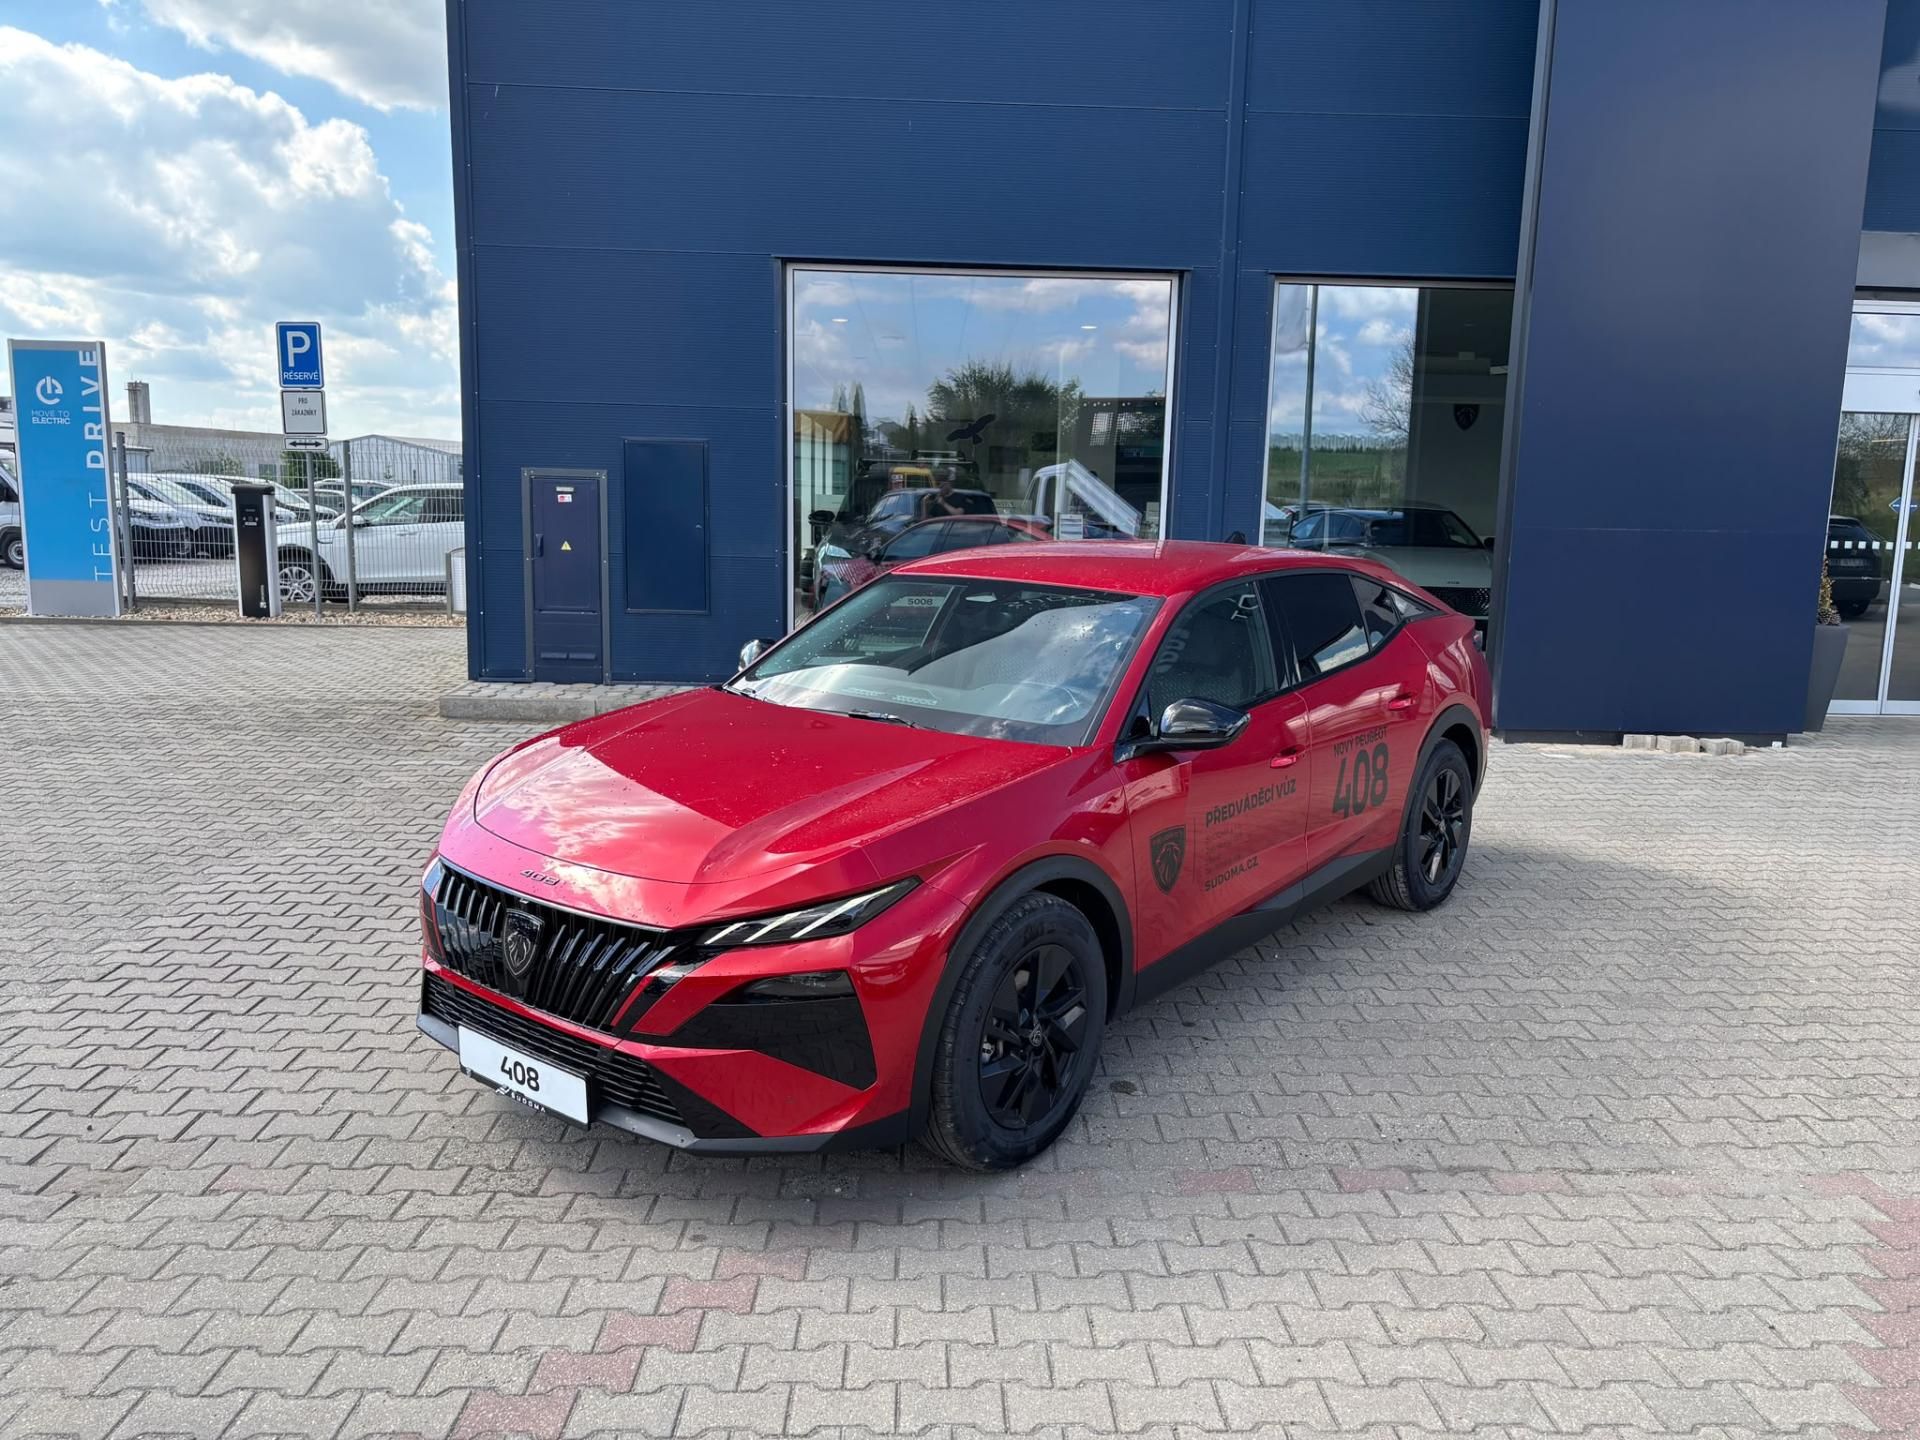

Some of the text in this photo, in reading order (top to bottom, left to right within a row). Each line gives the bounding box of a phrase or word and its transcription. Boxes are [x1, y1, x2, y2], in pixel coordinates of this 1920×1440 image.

[286, 331, 311, 367] P
[283, 371, 319, 380] RÉSERVÉ
[79, 350, 114, 581] TEST DRIVE
[1332, 743, 1389, 819] 408
[1204, 856, 1259, 892] SUDOMA.CZ
[501, 1055, 540, 1092] 408
